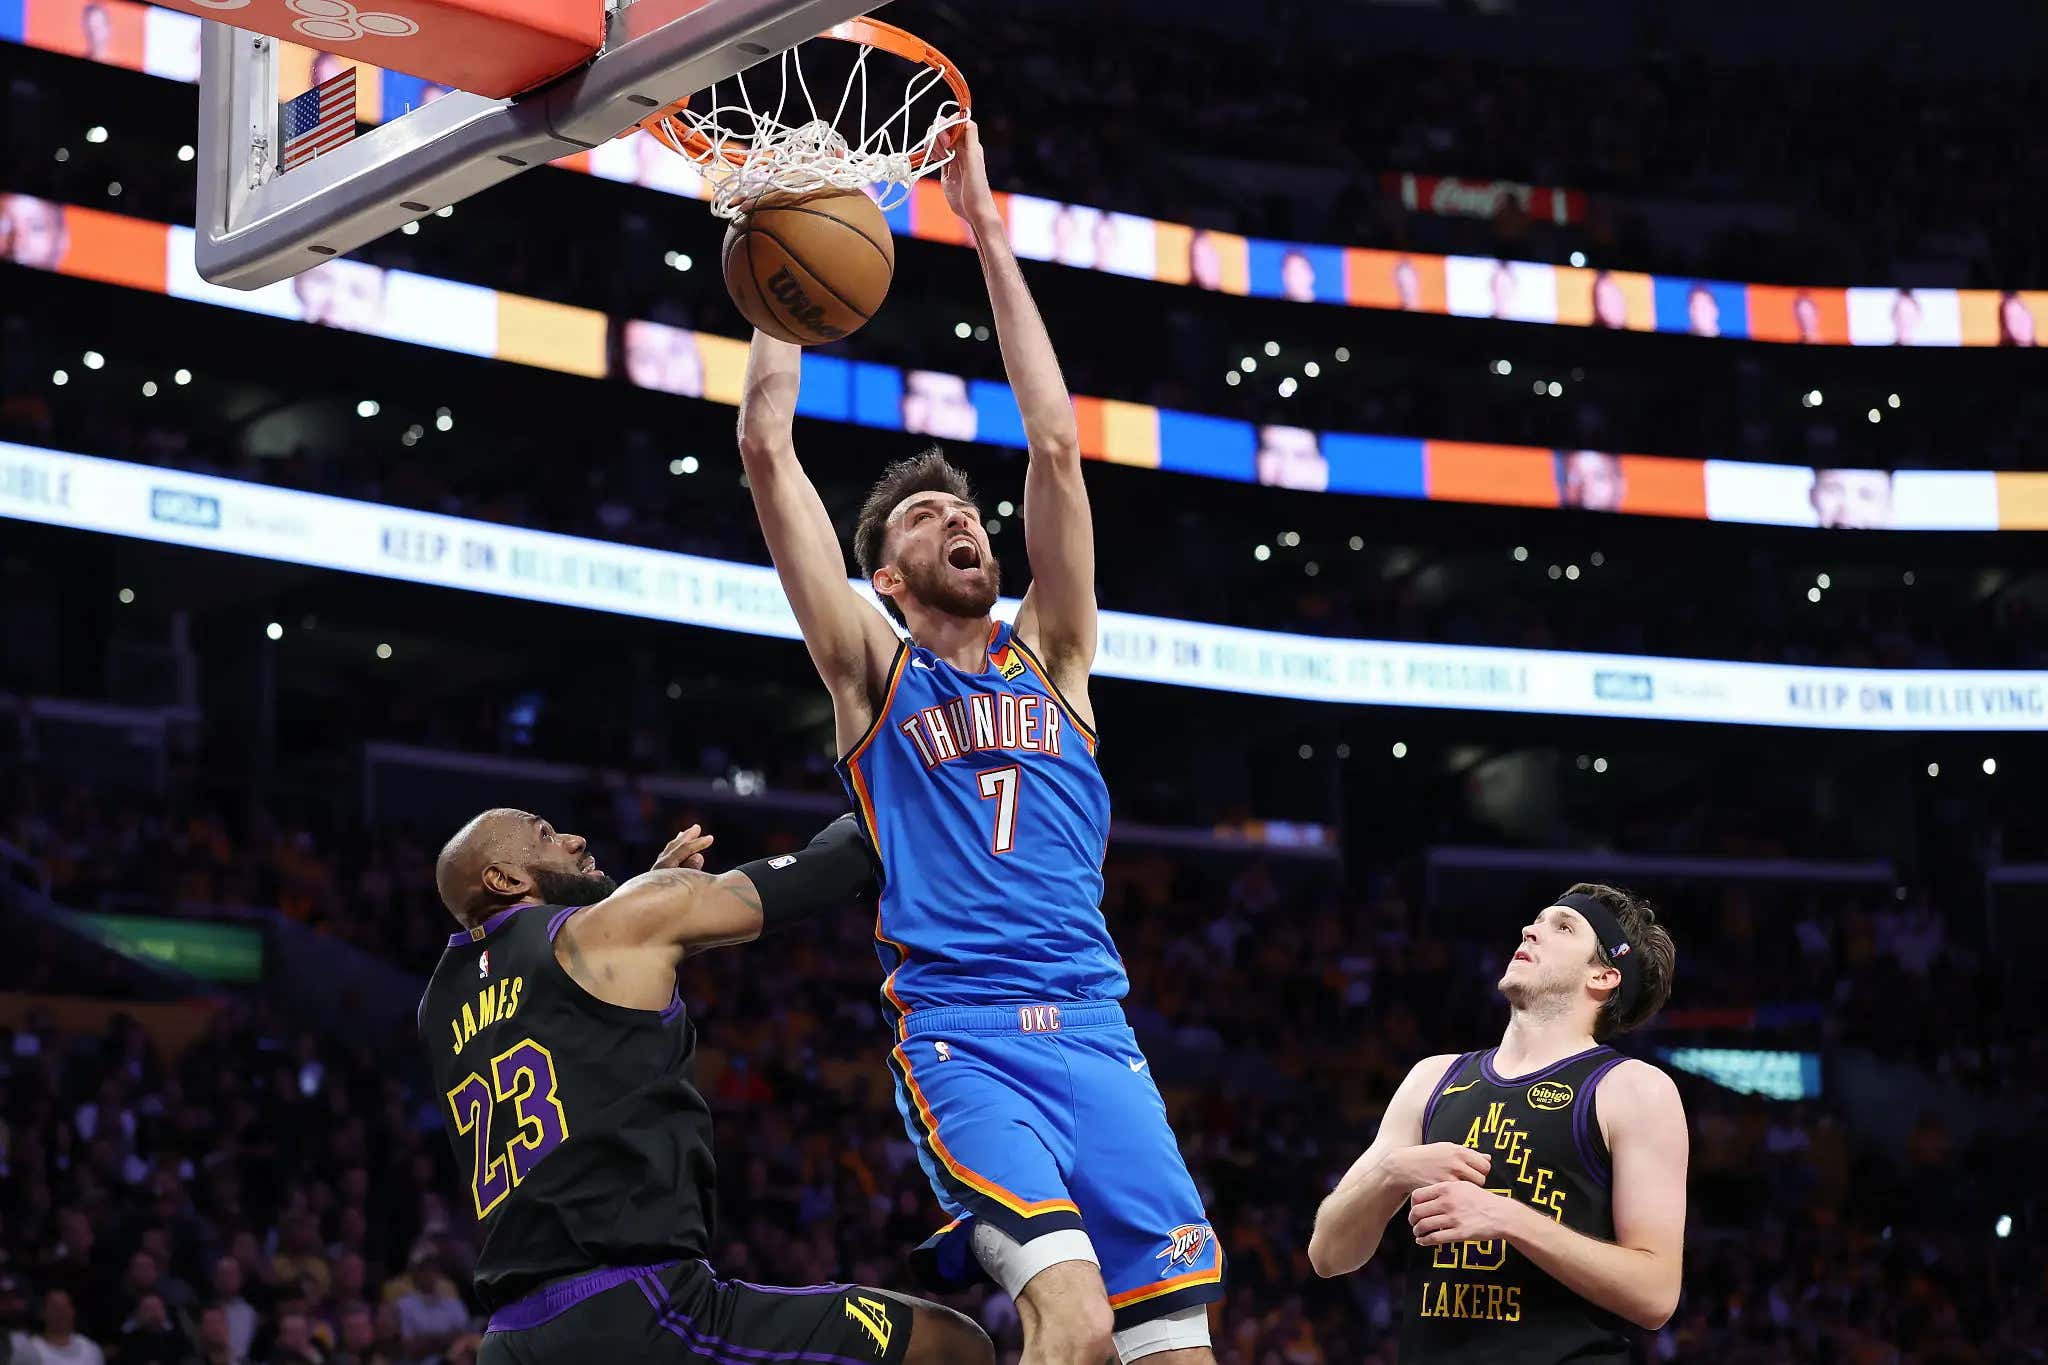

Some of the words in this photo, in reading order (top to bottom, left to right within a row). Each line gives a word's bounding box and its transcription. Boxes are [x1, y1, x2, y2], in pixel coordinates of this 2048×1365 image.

[380, 525, 447, 564] KEEP
[461, 536, 498, 573] ON
[1102, 631, 1158, 662] KEEP
[1173, 638, 1200, 667] ON
[1787, 683, 1849, 711] KEEP
[1858, 686, 1894, 712] ON
[1904, 685, 2044, 715] BELIEVING
[899, 692, 1062, 770] THUNDER
[976, 764, 1021, 855] 7
[451, 976, 523, 1055] JAMES
[1020, 1005, 1061, 1033] OKC
[1532, 1087, 1571, 1103] bibigo
[447, 1038, 569, 1220] 23
[1462, 1102, 1567, 1225] ANGELES
[1420, 1281, 1521, 1322] LAKERS
